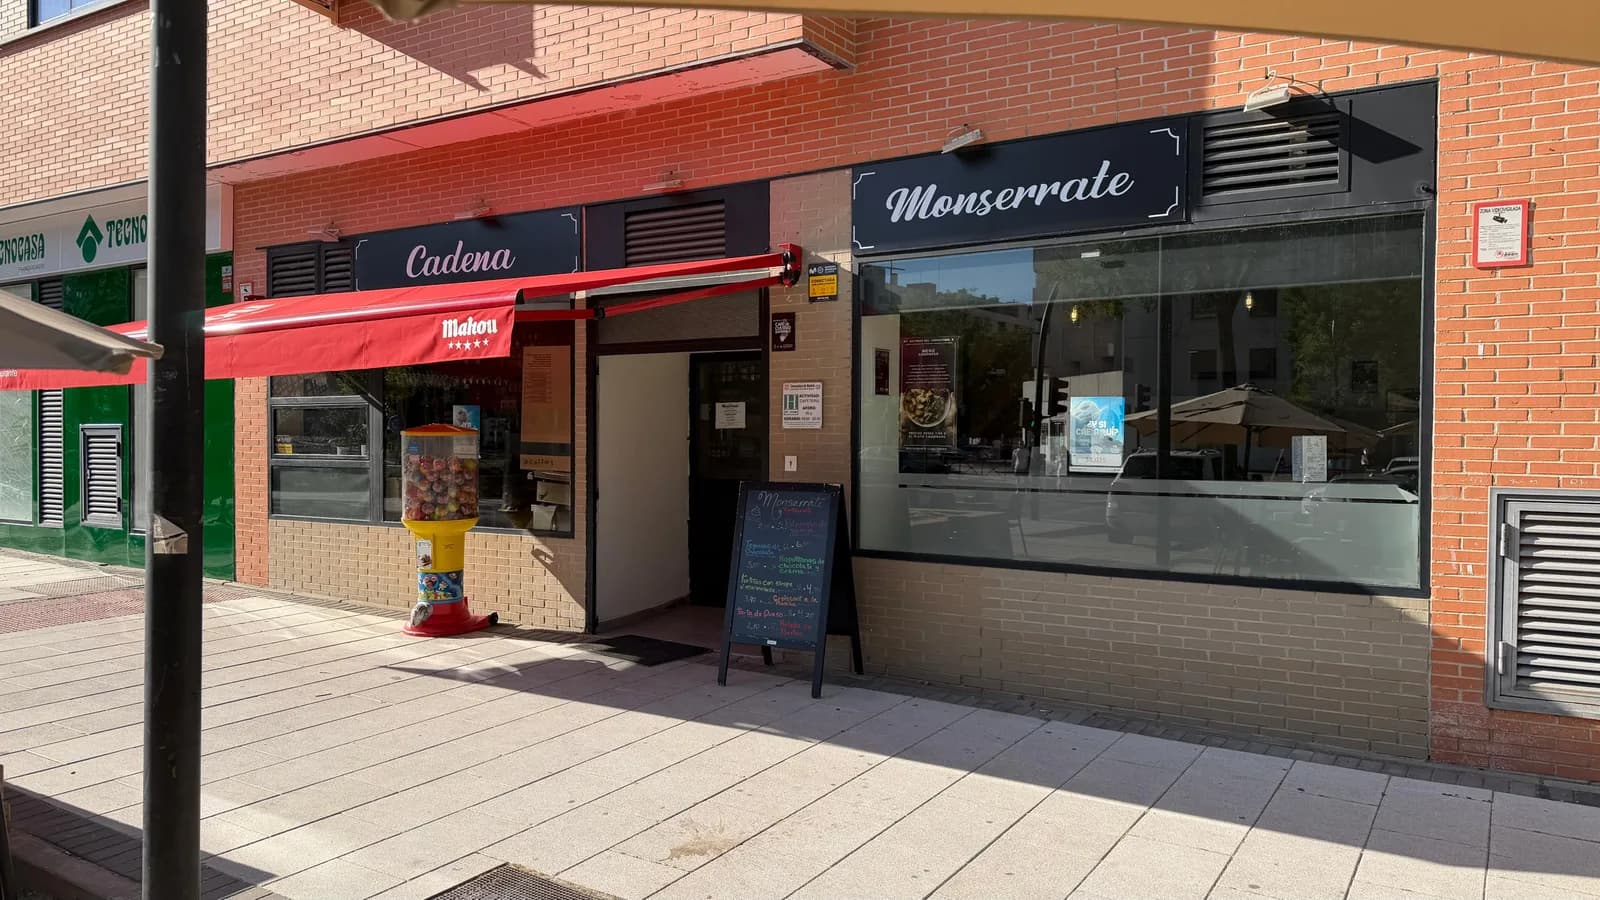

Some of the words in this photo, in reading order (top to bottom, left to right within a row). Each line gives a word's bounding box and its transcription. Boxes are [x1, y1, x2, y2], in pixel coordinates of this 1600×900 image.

[885, 160, 1135, 223] Monserrate
[406, 240, 516, 278] Cadena
[442, 316, 498, 338] Mahou
